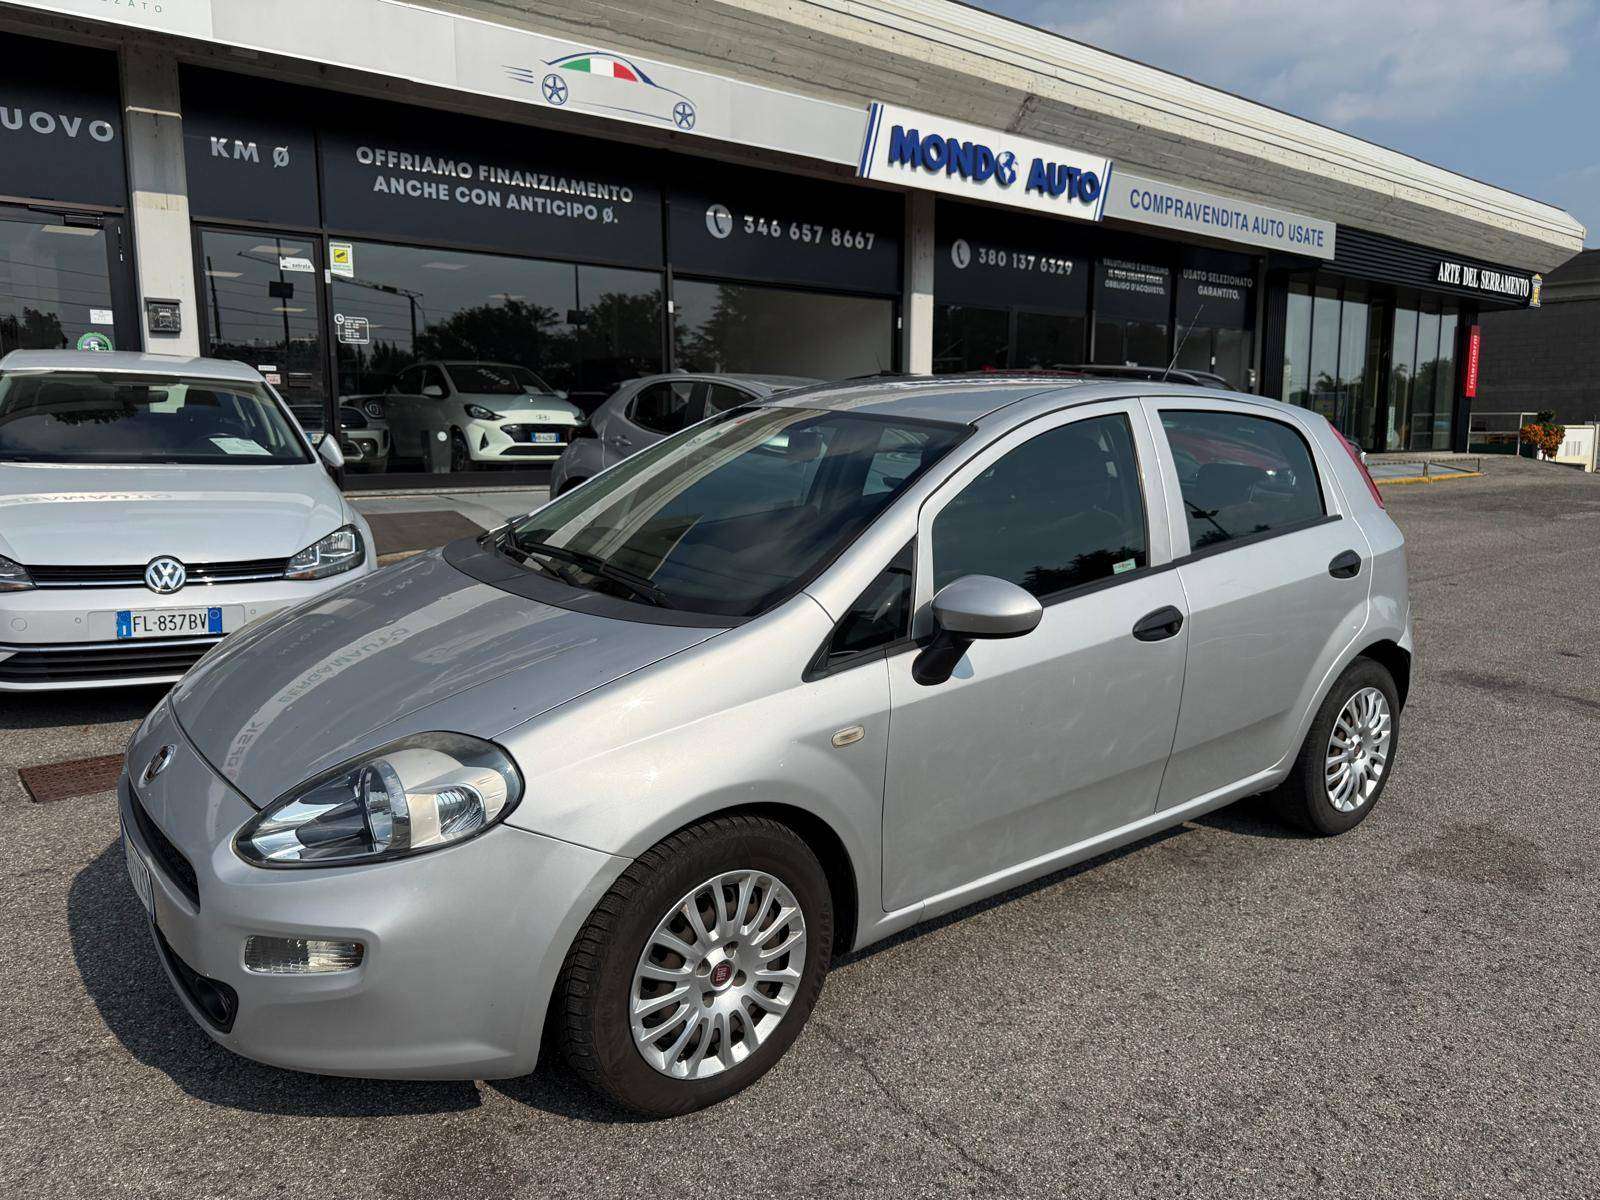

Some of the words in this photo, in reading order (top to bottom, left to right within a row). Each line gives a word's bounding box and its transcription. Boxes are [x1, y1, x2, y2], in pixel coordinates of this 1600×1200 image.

[210, 136, 260, 163] KM
[356, 146, 473, 180] OFFRIAMO
[479, 164, 634, 204] FINANZIAMENTO
[1024, 158, 1101, 204] AUTO
[373, 175, 449, 201] ANCHE
[455, 186, 501, 208] CON
[506, 194, 598, 221] ANTICIPO
[743, 215, 781, 237] 346
[789, 222, 823, 244] 657
[831, 228, 875, 250] 8667
[1130, 188, 1249, 232] COMPRAVENDITA
[1252, 215, 1284, 239] AUTO
[1288, 223, 1324, 248] USATE
[978, 248, 1007, 267] 380
[1012, 252, 1035, 271] 137
[1039, 256, 1073, 275] 6329
[1183, 269, 1207, 282] USATO
[1208, 272, 1253, 288] SELEZIONATO
[1438, 262, 1461, 285] ARTE
[1462, 266, 1479, 289] DEL
[1480, 271, 1530, 297] SERRAMENTO
